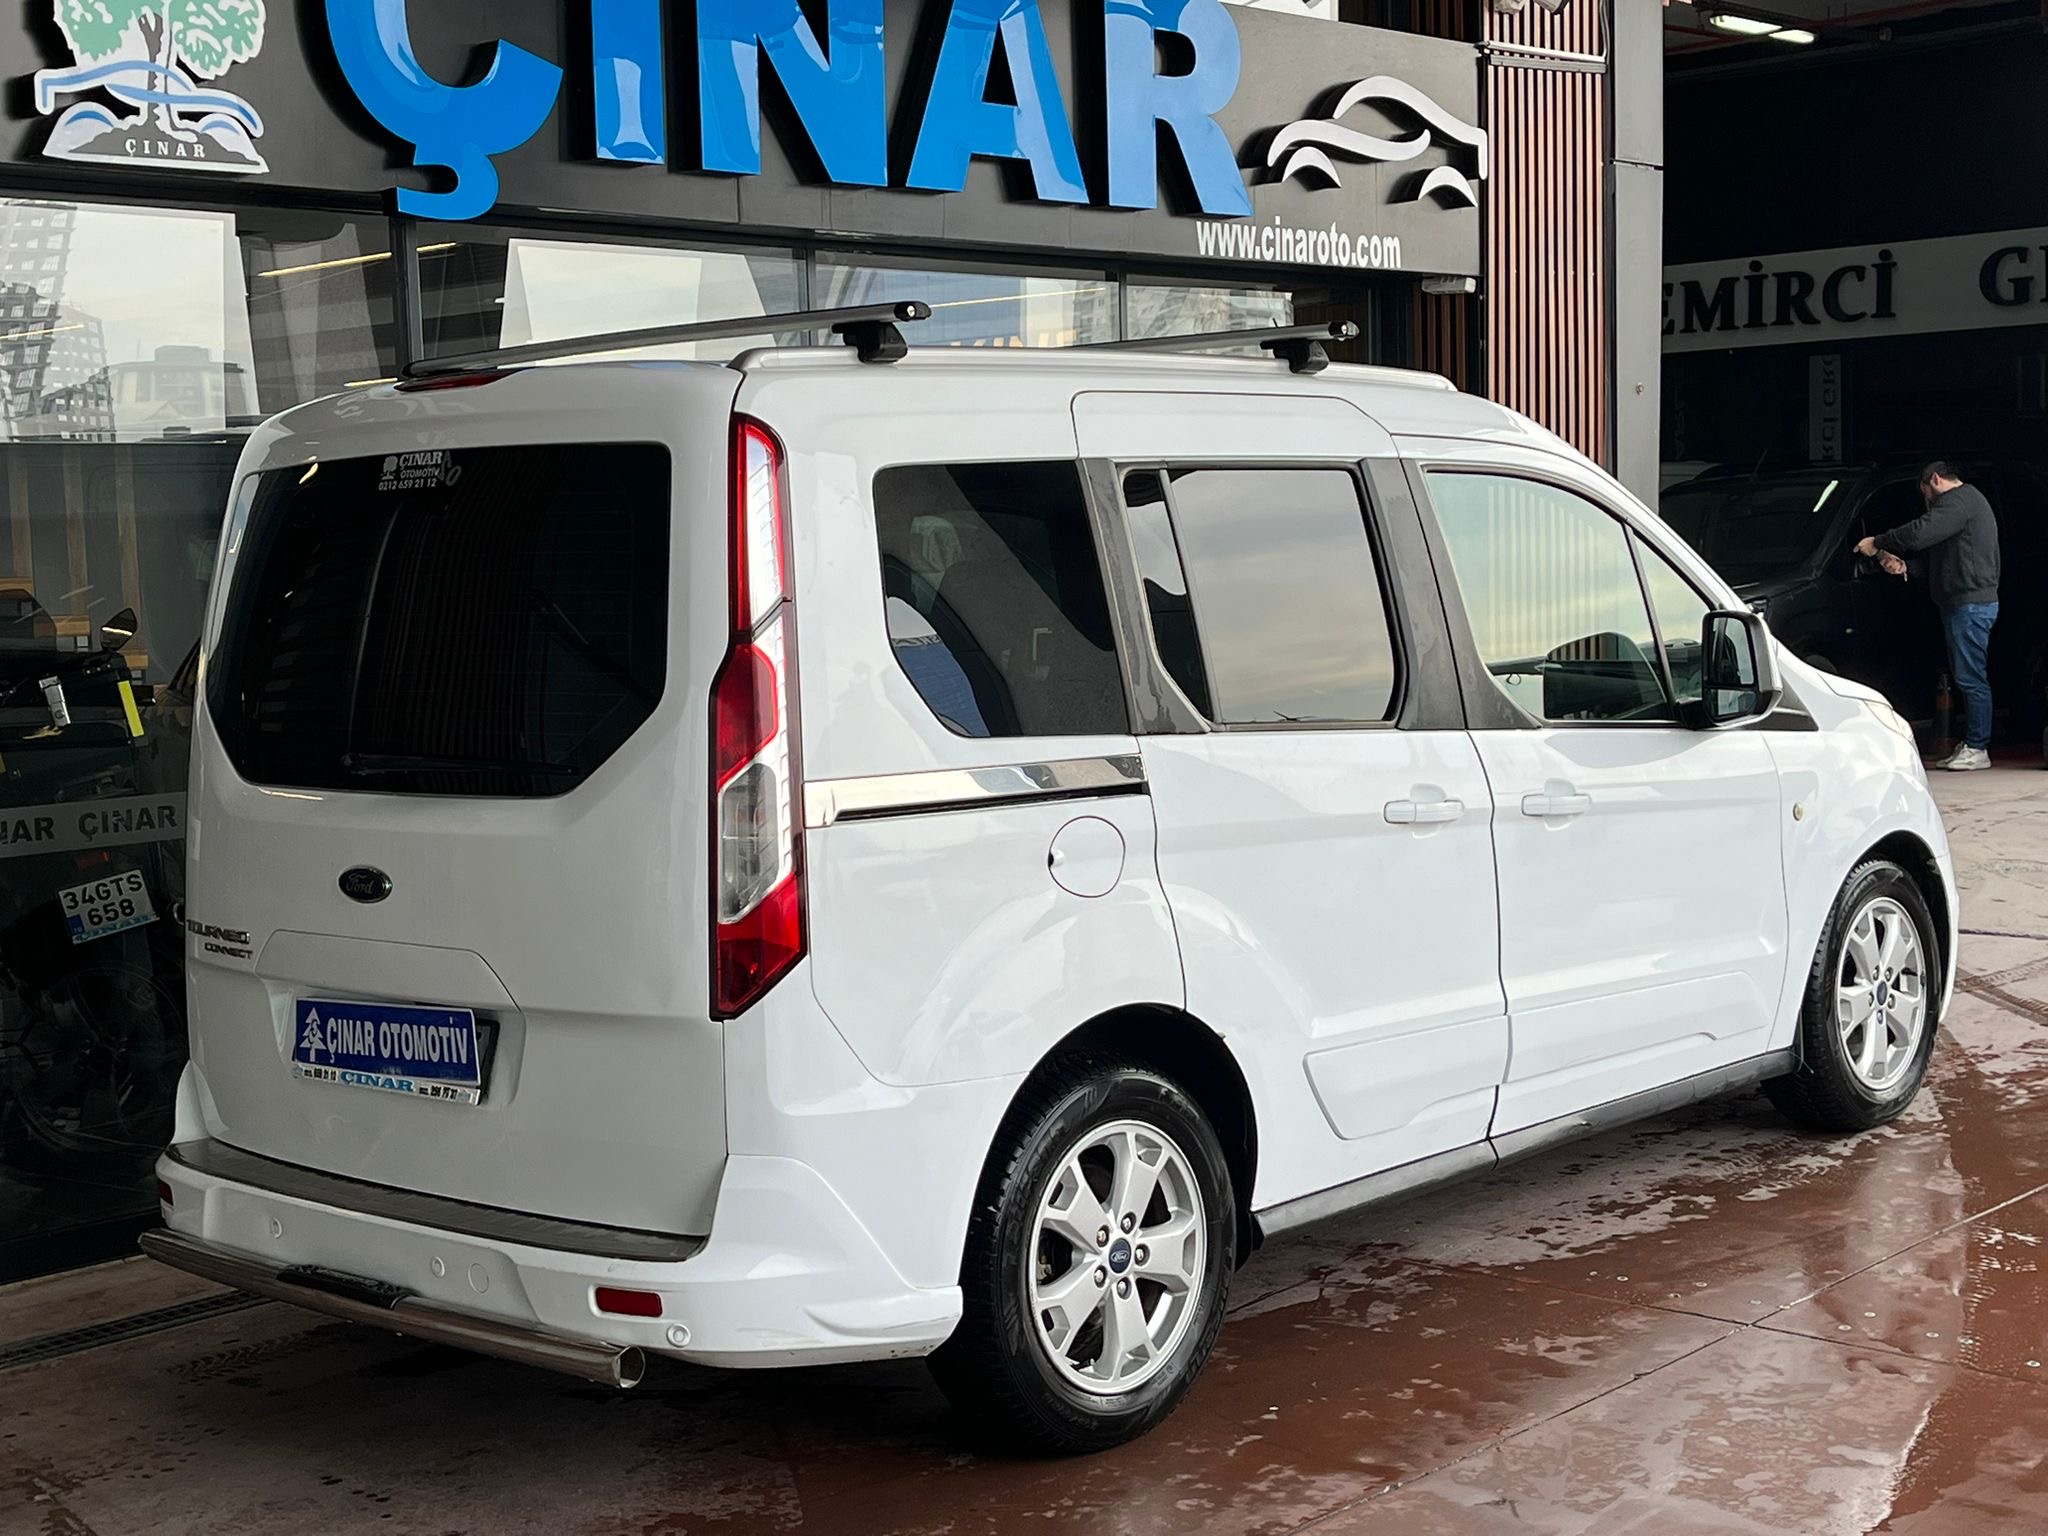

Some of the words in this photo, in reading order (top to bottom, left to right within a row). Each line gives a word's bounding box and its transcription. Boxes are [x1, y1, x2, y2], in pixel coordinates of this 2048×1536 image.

[326, 0, 1252, 220] ÇINAR
[125, 138, 206, 159] ÇINAR
[1196, 215, 1402, 269] www.cinaroto.com
[1979, 245, 2048, 307] G
[399, 451, 443, 470] ÇINAR
[378, 481, 398, 491] 0212
[398, 480, 414, 489] 659
[414, 478, 424, 488] 21
[427, 478, 437, 487] 12
[78, 805, 178, 842] ÇINAR
[346, 872, 376, 895] Ford
[87, 898, 135, 926] 658
[186, 919, 250, 945] TOURNEO
[204, 942, 253, 960] CONNECT
[326, 1017, 376, 1064] ÇINAR
[379, 1016, 468, 1065] OTOMOTİV
[340, 1070, 415, 1093] ÇINAR
